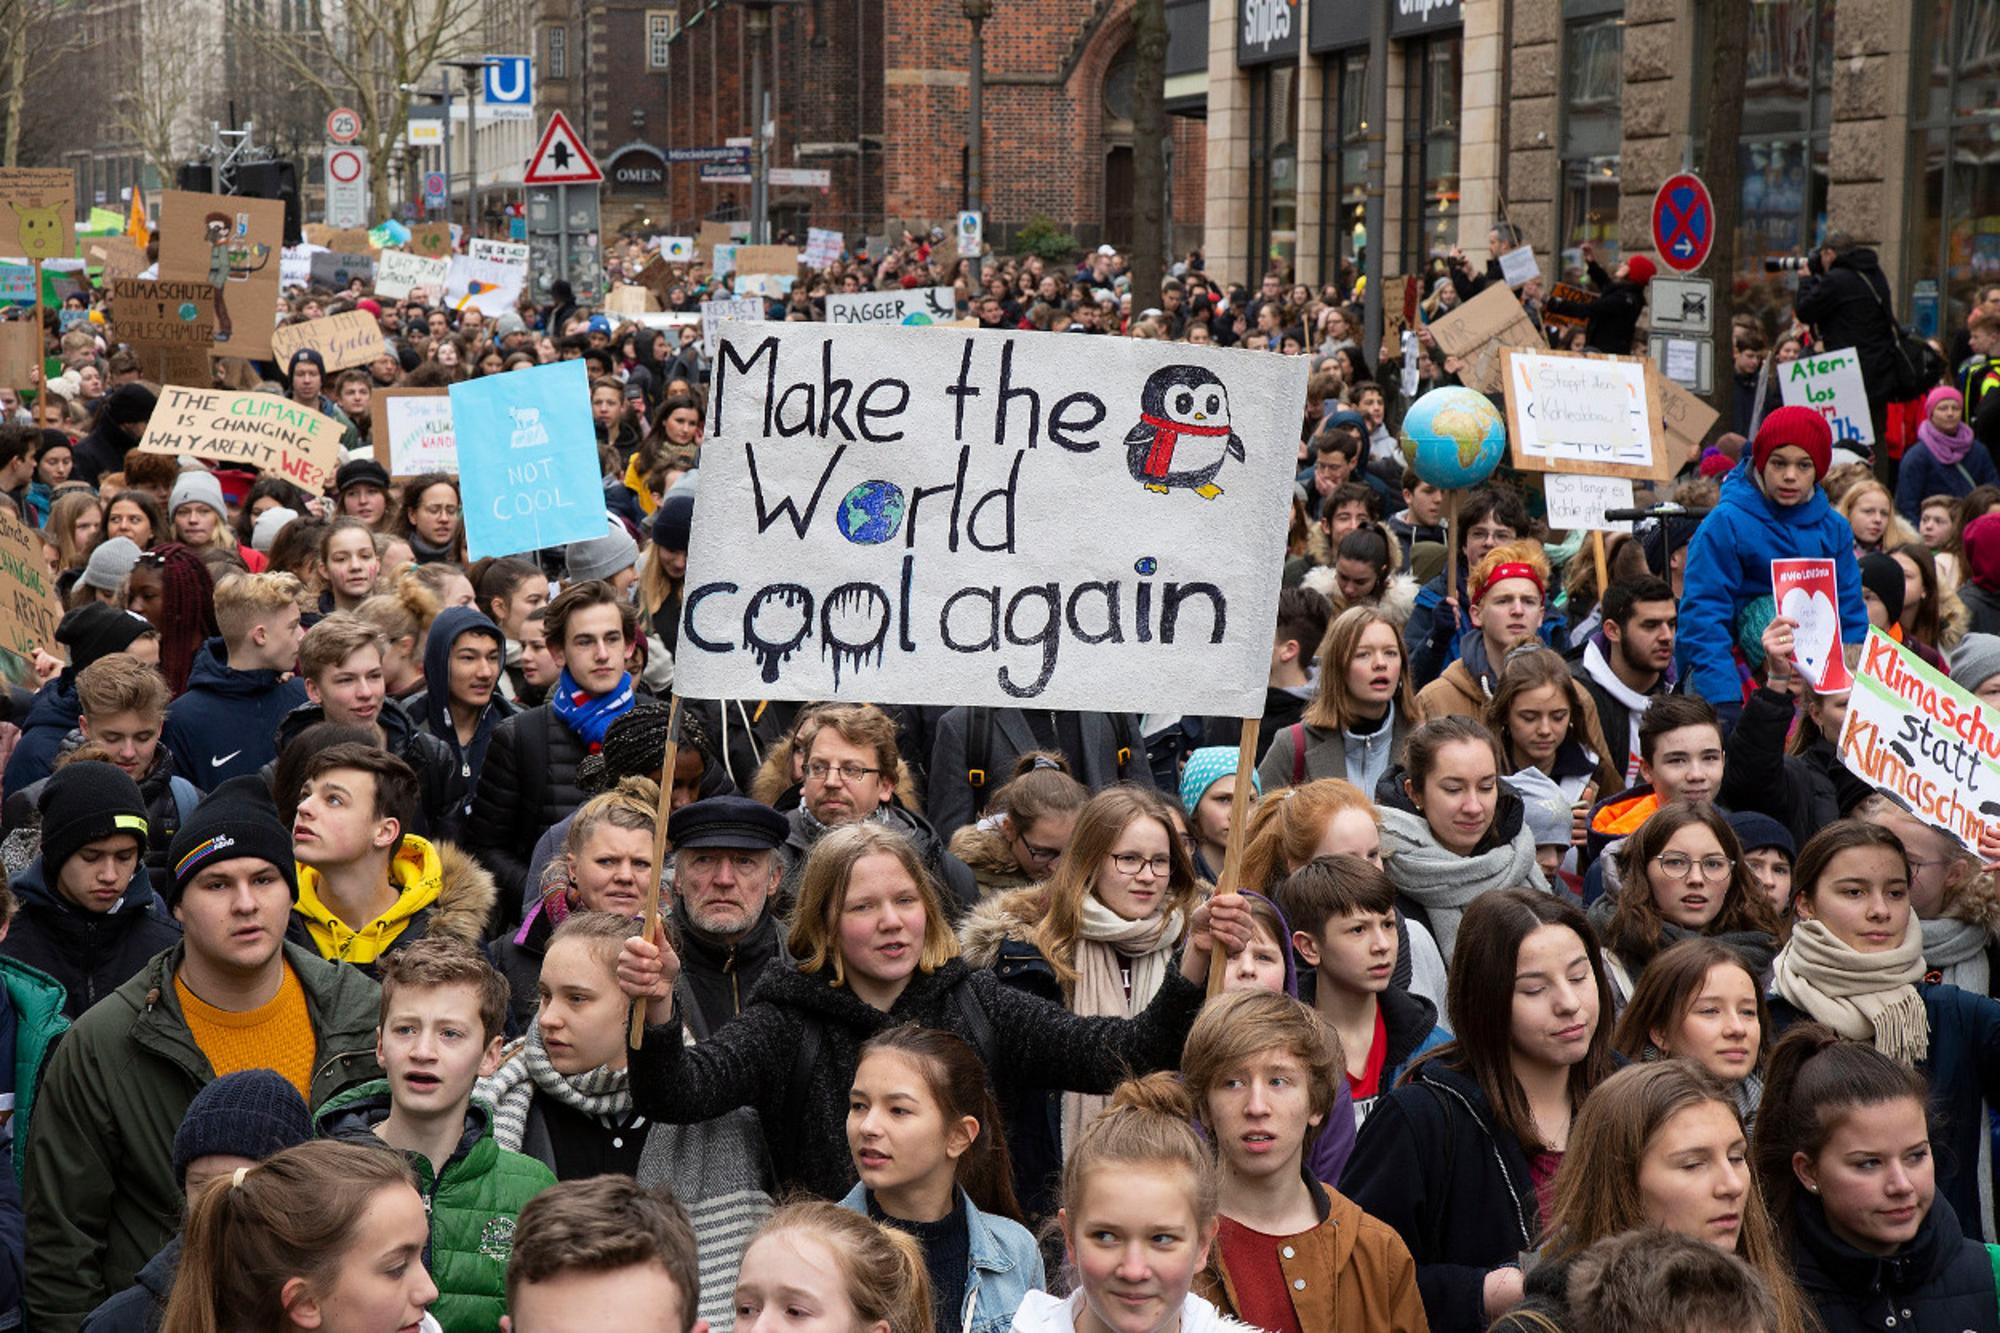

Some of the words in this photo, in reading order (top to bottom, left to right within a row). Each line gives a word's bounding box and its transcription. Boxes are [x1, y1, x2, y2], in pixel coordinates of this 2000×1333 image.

[490, 60, 525, 101] U
[335, 118, 354, 133] 25
[616, 168, 662, 182] OMEN
[114, 281, 213, 300] KLIMASCHUTZ
[833, 300, 905, 324] BAGGER
[1791, 357, 1854, 382] Atem-
[169, 389, 221, 413] THE
[230, 396, 322, 436] CLIMATE
[713, 336, 910, 443] Make
[945, 338, 1106, 452] the
[176, 413, 197, 428] IS
[210, 416, 313, 454] CHANGING
[148, 431, 202, 451] WHY
[201, 436, 277, 463] AREN'T
[281, 449, 325, 487] WE?
[507, 456, 553, 486] NOT
[493, 487, 576, 521] COOL
[683, 555, 917, 692] cool
[940, 556, 1227, 698] again
[1897, 714, 1982, 791] statt
